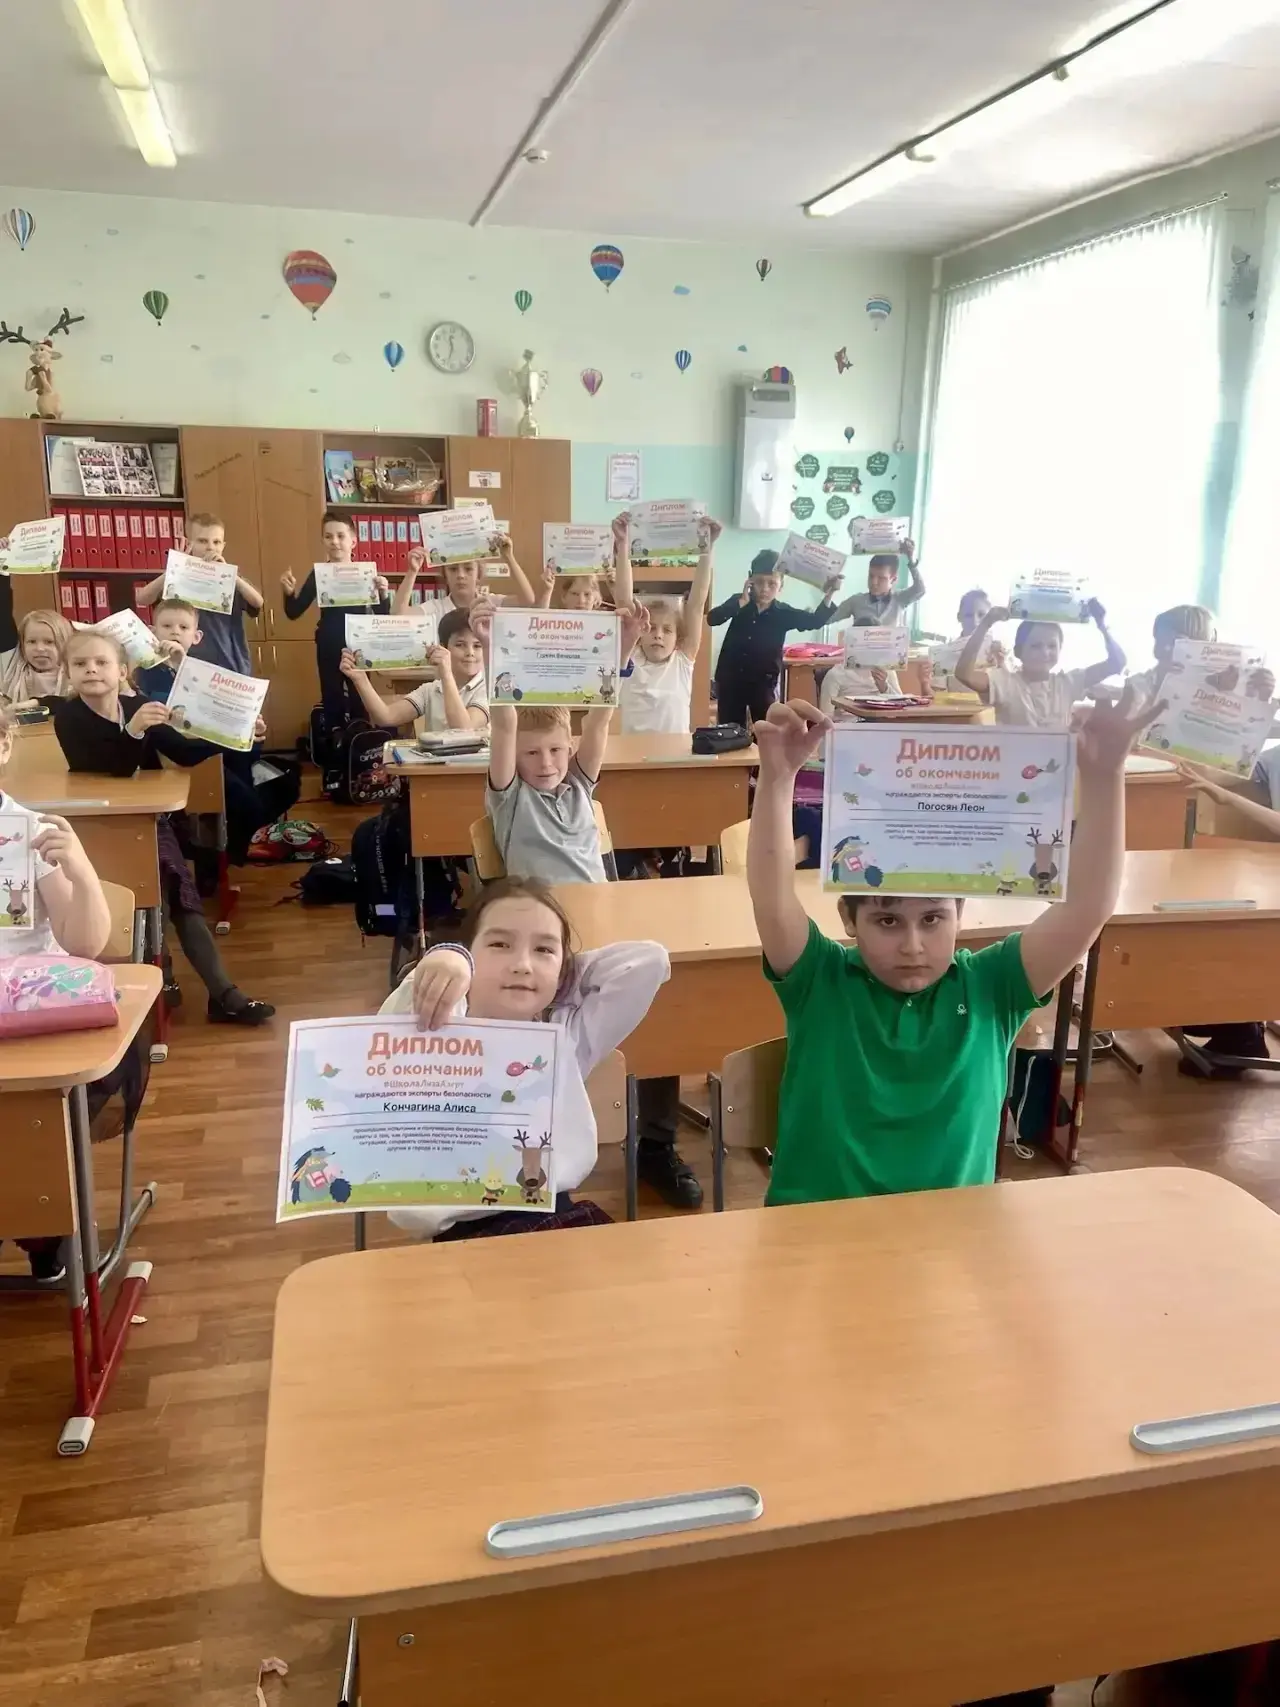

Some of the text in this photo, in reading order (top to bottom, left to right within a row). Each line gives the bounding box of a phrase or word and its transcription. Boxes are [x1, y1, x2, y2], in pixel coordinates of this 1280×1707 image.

[528, 616, 584, 631] Диплом
[210, 671, 256, 693] Диплом
[895, 738, 1001, 764] Диплом
[895, 766, 1000, 781] об окончании
[917, 801, 985, 813] Погосян Леон
[367, 1032, 484, 1060] Диплом
[366, 1063, 484, 1078] об окончании
[354, 1089, 492, 1100] награждаются эксперты безопасности
[383, 1102, 477, 1113] Кончагина Алиса
